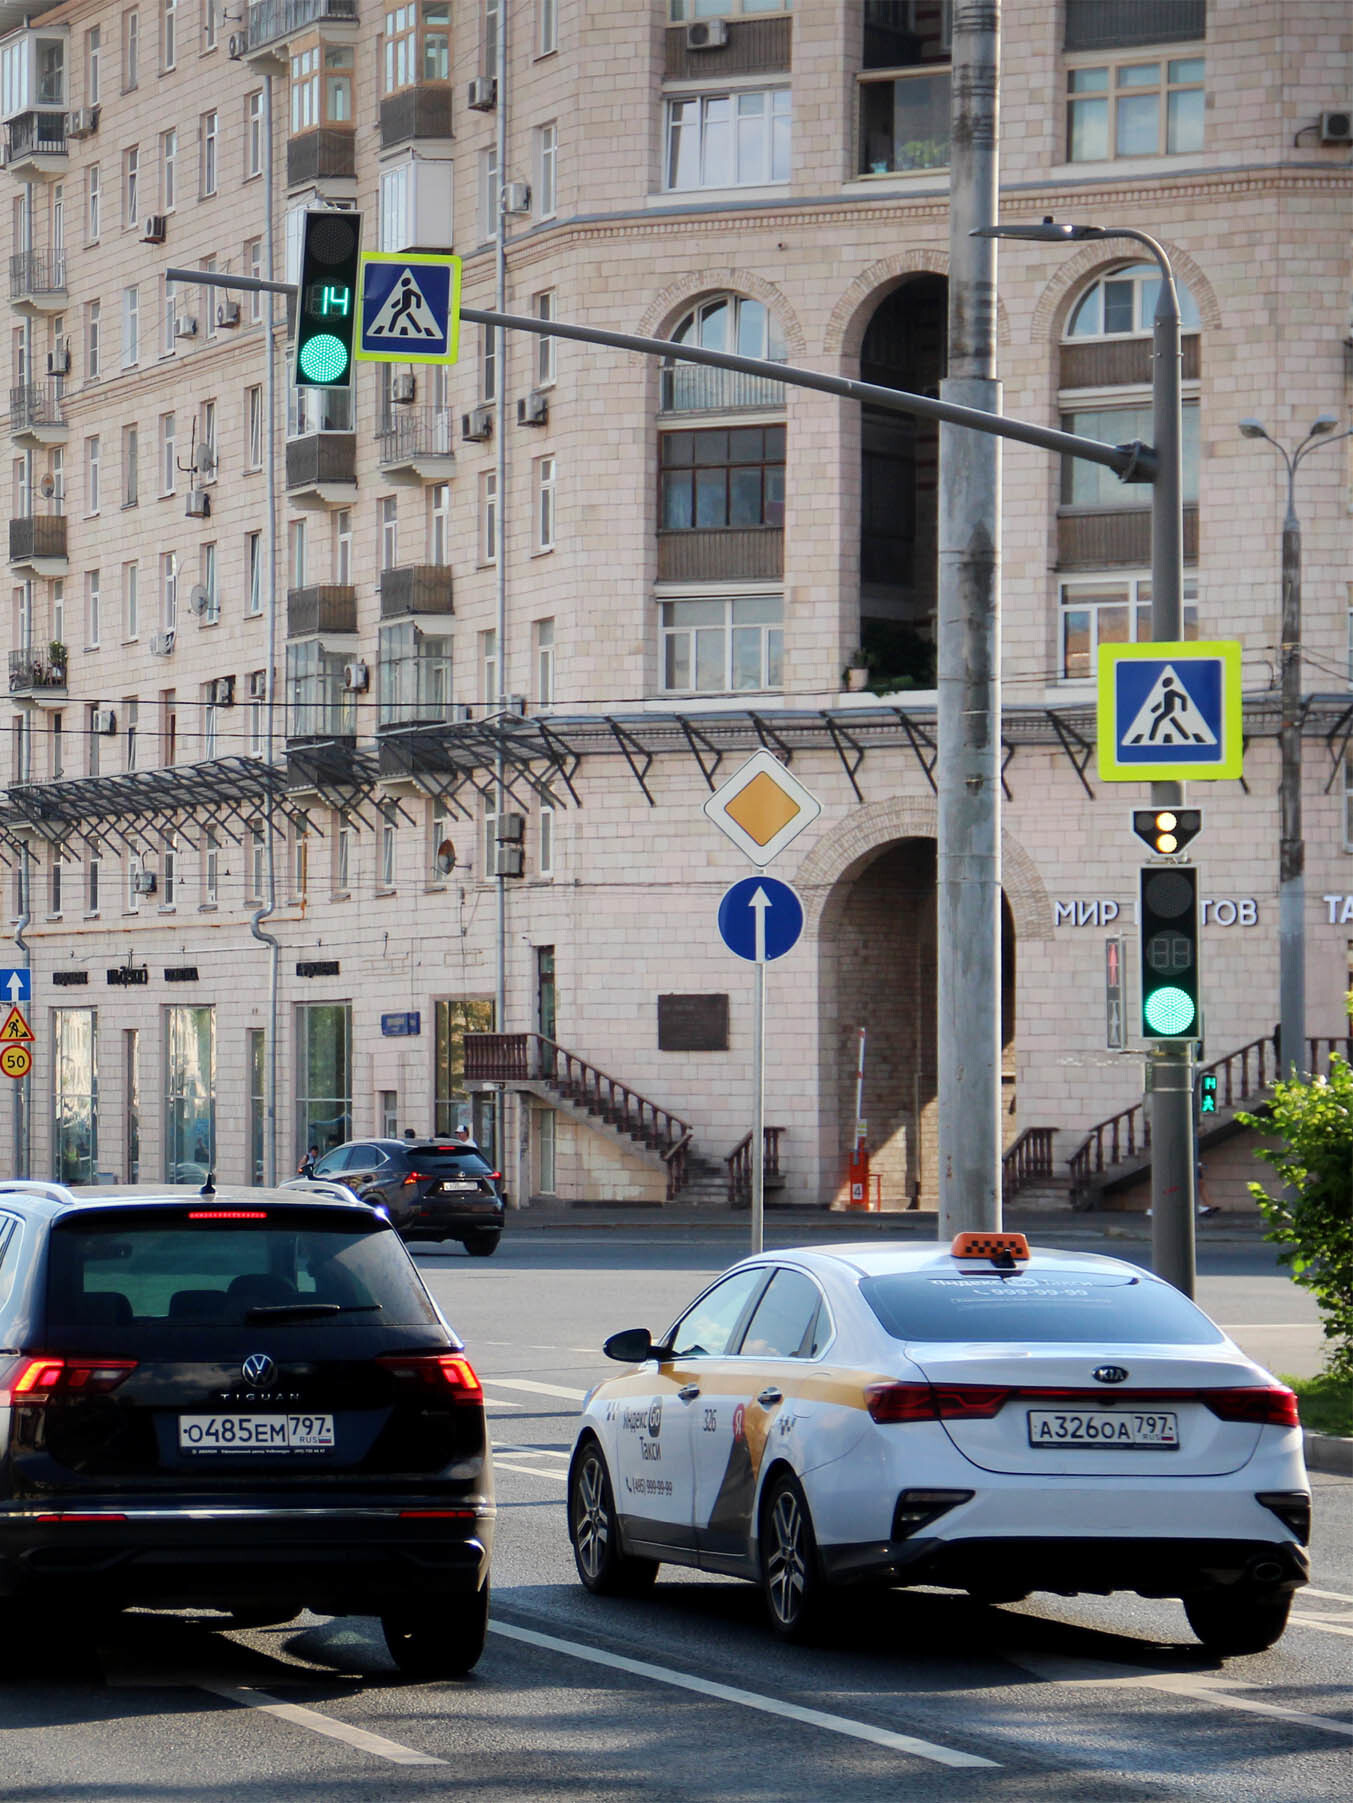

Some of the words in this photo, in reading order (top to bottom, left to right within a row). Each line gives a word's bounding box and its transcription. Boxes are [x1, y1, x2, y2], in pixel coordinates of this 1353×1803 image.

[322, 286, 349, 316] 14
[1053, 900, 1120, 927] МИР
[7, 1055, 25, 1068] 50
[1097, 1368, 1126, 1382] KIA
[188, 1418, 286, 1443] О485ЕМ
[289, 1417, 326, 1435] 797
[703, 1409, 717, 1432] 326
[1039, 1415, 1131, 1440] А326ОА
[1135, 1416, 1168, 1434] 797
[299, 1436, 318, 1444] RUS
[639, 1436, 662, 1461] Такси
